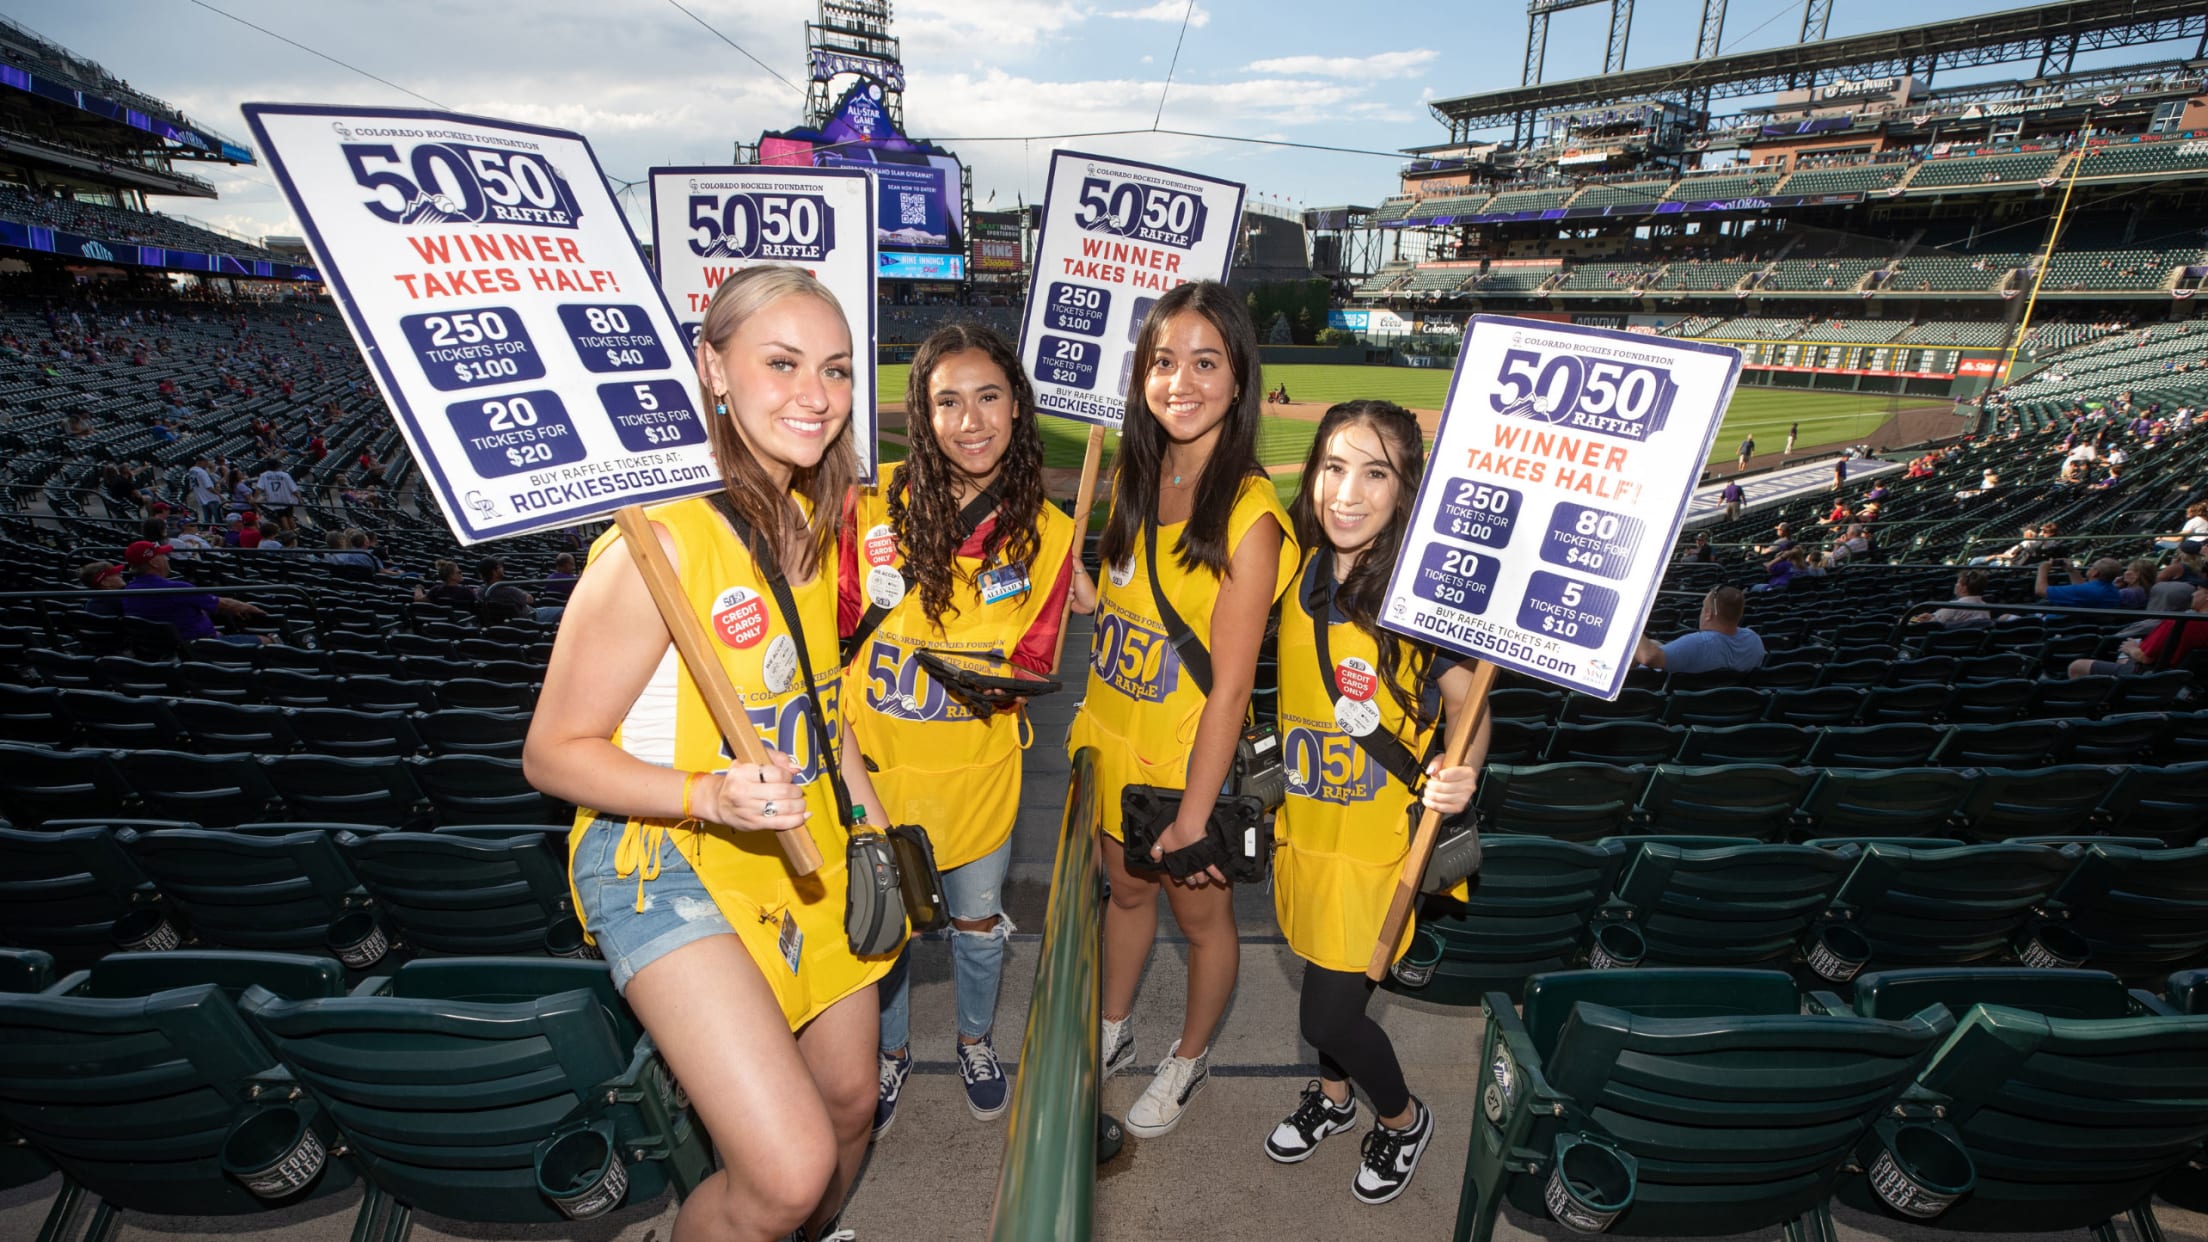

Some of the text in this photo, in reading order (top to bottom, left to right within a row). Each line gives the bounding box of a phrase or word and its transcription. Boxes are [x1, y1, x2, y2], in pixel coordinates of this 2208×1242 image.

[811, 49, 905, 92] ROCKIES
[848, 106, 880, 118] ALL-STAR
[854, 115, 875, 126] GAME
[1983, 103, 2026, 118] Silver
[355, 128, 424, 138] COLORADO
[427, 130, 474, 142] ROCKIES
[476, 133, 539, 151] FOUNDATION
[700, 182, 740, 190] COLORADO
[774, 183, 824, 191] FOUNDATION
[1096, 168, 1204, 192] COLORADO ROCKIES FOUNDATION
[492, 205, 570, 225] RAFFLE
[1139, 227, 1189, 246] RAFFLE
[407, 233, 585, 265] WINNER
[762, 244, 820, 258] RAFFLE
[982, 244, 1012, 256] KING
[1082, 237, 1181, 273] WINNER
[1063, 258, 1125, 283] TAKES
[394, 267, 621, 300] TAKES HALF!
[1059, 286, 1101, 308] 250
[585, 307, 632, 335] 80
[1052, 303, 1103, 320] TICKETS FOR
[1058, 315, 1091, 331] $100
[1424, 314, 1453, 324] Bank of
[424, 311, 509, 347] 250
[1422, 324, 1459, 334] Colorado
[425, 340, 527, 363] TICKETS FOR
[578, 334, 655, 348] TICKETS FOR
[1055, 340, 1084, 361] 20
[1525, 337, 1674, 366] COLORADO ROCKIES FOUNDATION
[606, 348, 645, 367] $40
[1042, 356, 1093, 373] TICKETS FOR
[1406, 356, 1431, 366] YETI
[454, 358, 519, 383] $100
[1052, 368, 1077, 383] $20
[634, 385, 660, 411] 5
[1040, 394, 1124, 420] ROCKIES505
[1056, 387, 1073, 397] BUY
[1074, 390, 1104, 404] RAFFLE
[482, 397, 539, 431] 20
[618, 409, 692, 427] TICKETS FOR
[1572, 412, 1643, 437] RAFFLE
[471, 423, 568, 451] TICKETS FOR
[644, 425, 682, 445] $10
[505, 442, 554, 467] $20
[1494, 423, 1628, 473] WINNER
[529, 452, 684, 488] BUY RAFFLE TICKETS AT:
[1467, 448, 1644, 505] TAKES HALF!
[271, 482, 281, 492] 17
[510, 463, 711, 514] ROCKIES5050.com
[1455, 482, 1510, 514] 250
[1445, 503, 1509, 528] TICKETS FOR
[1575, 510, 1620, 540] 80
[1450, 520, 1492, 541] $100
[1552, 530, 1602, 550] TICKETS
[870, 546, 893, 556] CARDS
[873, 554, 891, 563] ONLY
[1566, 548, 1604, 570] $40
[1441, 549, 1479, 578] 20
[1424, 567, 1487, 594] TICKETS FOR
[1434, 583, 1465, 604] $20
[1560, 581, 1585, 607] 5
[722, 602, 758, 625] CREDIT
[1530, 597, 1604, 628] TICKETS FOR
[727, 614, 762, 635] CARDS
[735, 626, 761, 644] ONLY
[1435, 605, 1562, 653] BUY RAFFLE TICKETS AT:
[1542, 618, 1579, 639] $10
[1413, 611, 1577, 678] ROCKIES5050.com
[1341, 670, 1370, 683] CREDIT
[1341, 677, 1368, 691] CARDS
[1344, 686, 1364, 697] ONLY
[2027, 942, 2057, 967] COORS
[1487, 1089, 1500, 1112] 27
[279, 1133, 316, 1176] COORS
[288, 1143, 323, 1186] FIELD
[1872, 1165, 1909, 1207] FIELD
[1880, 1154, 1917, 1197] COORS
